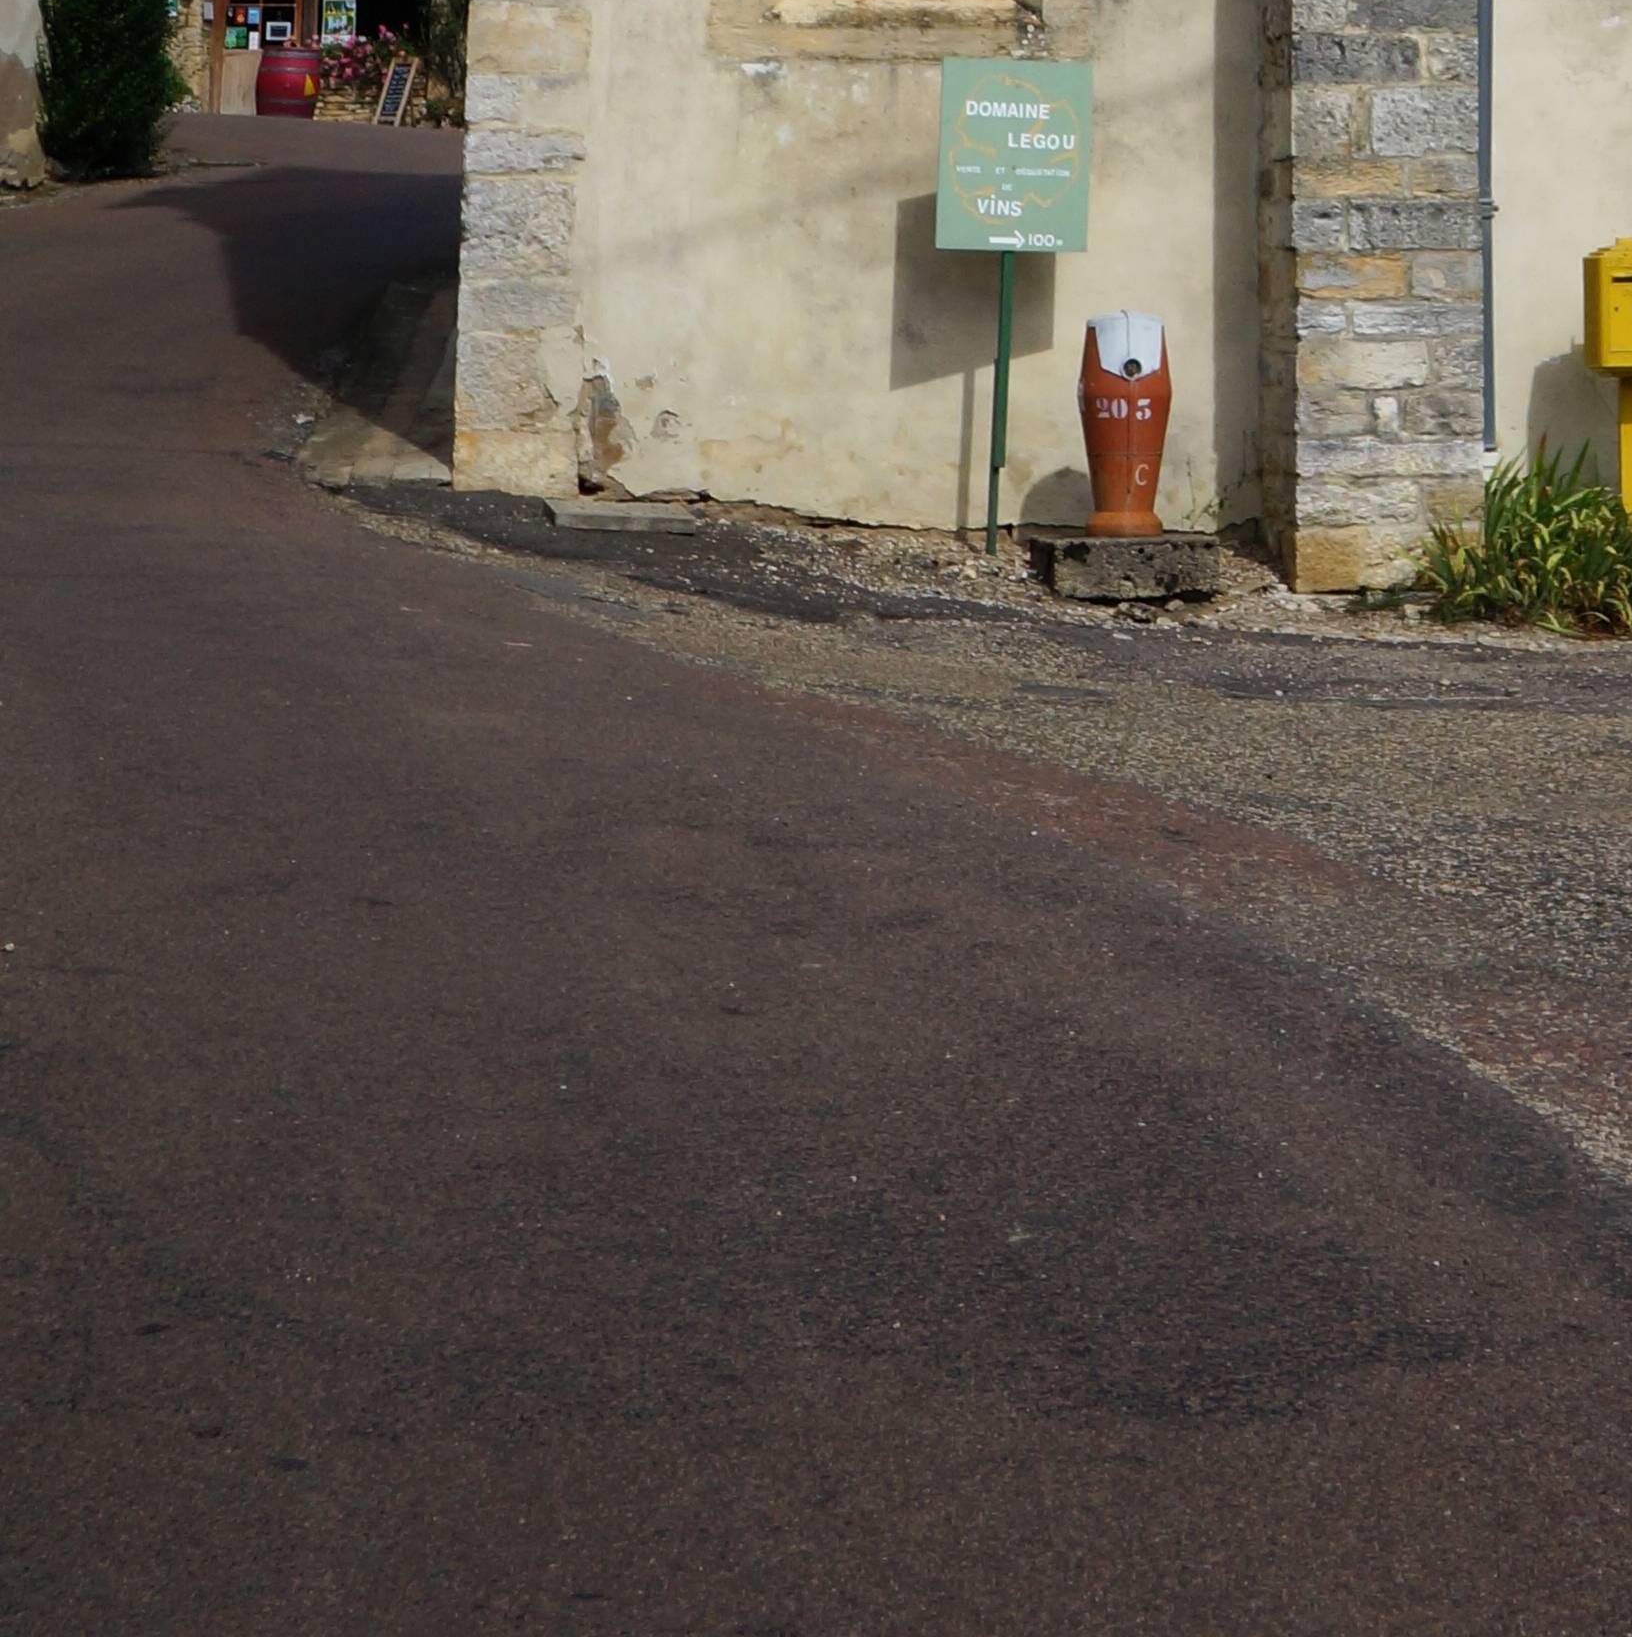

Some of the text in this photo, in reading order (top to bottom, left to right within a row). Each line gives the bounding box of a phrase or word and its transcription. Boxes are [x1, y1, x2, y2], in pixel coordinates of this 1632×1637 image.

[965, 100, 1050, 120] DOMAINE
[1007, 132, 1076, 150] LEGOU
[1135, 463, 1149, 486] C
